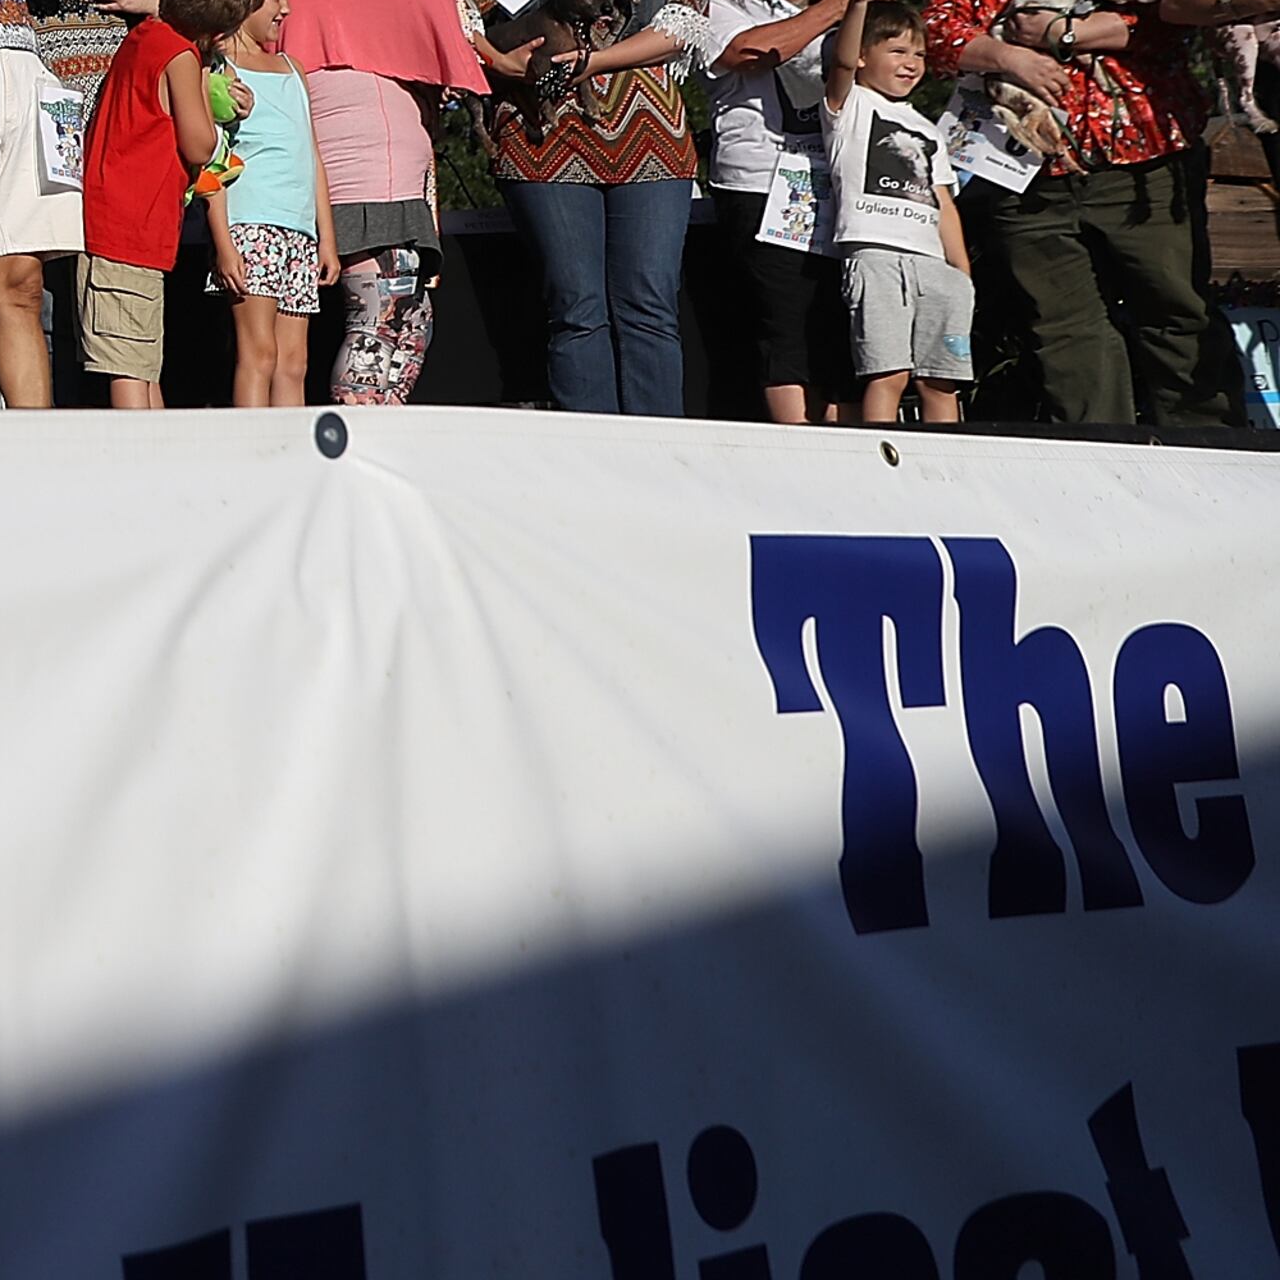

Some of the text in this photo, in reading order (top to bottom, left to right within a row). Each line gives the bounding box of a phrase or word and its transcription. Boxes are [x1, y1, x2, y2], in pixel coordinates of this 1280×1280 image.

[879, 176, 932, 195] Go Josie
[856, 200, 927, 224] Ugliest Dog
[748, 533, 1256, 935] The
